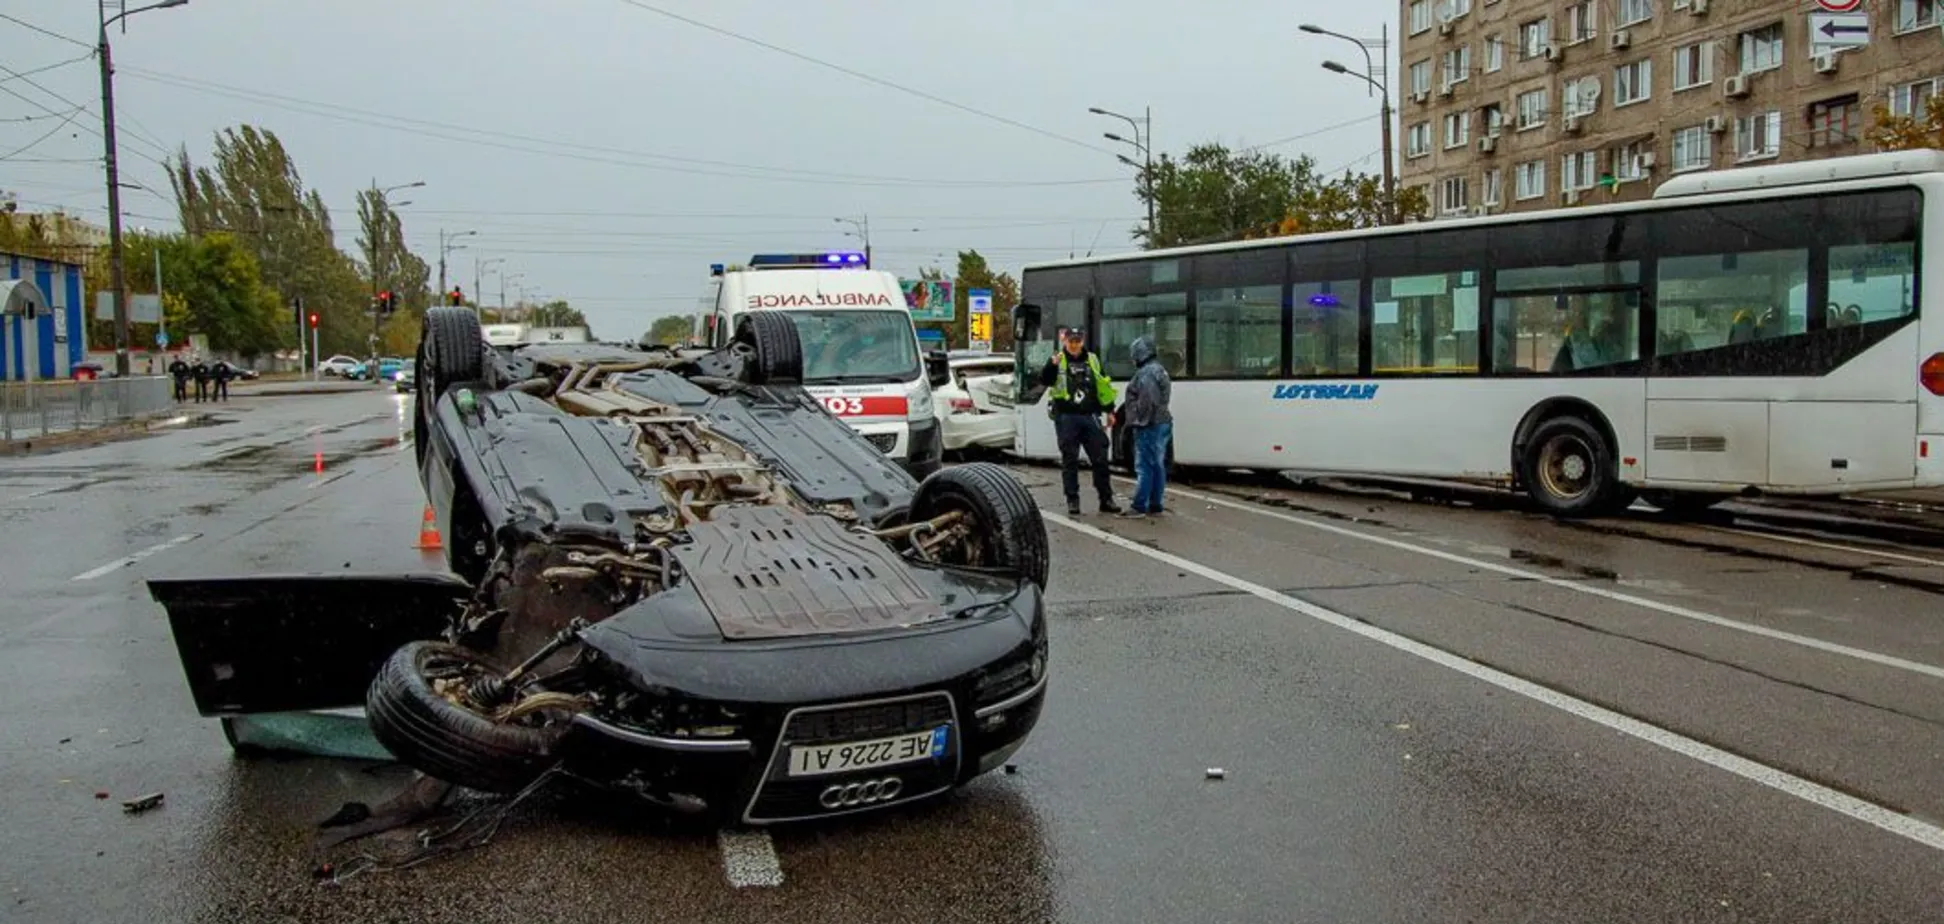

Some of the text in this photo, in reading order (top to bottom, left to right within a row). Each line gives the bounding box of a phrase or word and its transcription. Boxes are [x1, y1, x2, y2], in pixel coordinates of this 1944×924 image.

[1273, 384, 1379, 399] LOTSMAN
[839, 741, 894, 768] 2226
[900, 734, 931, 759] AE
